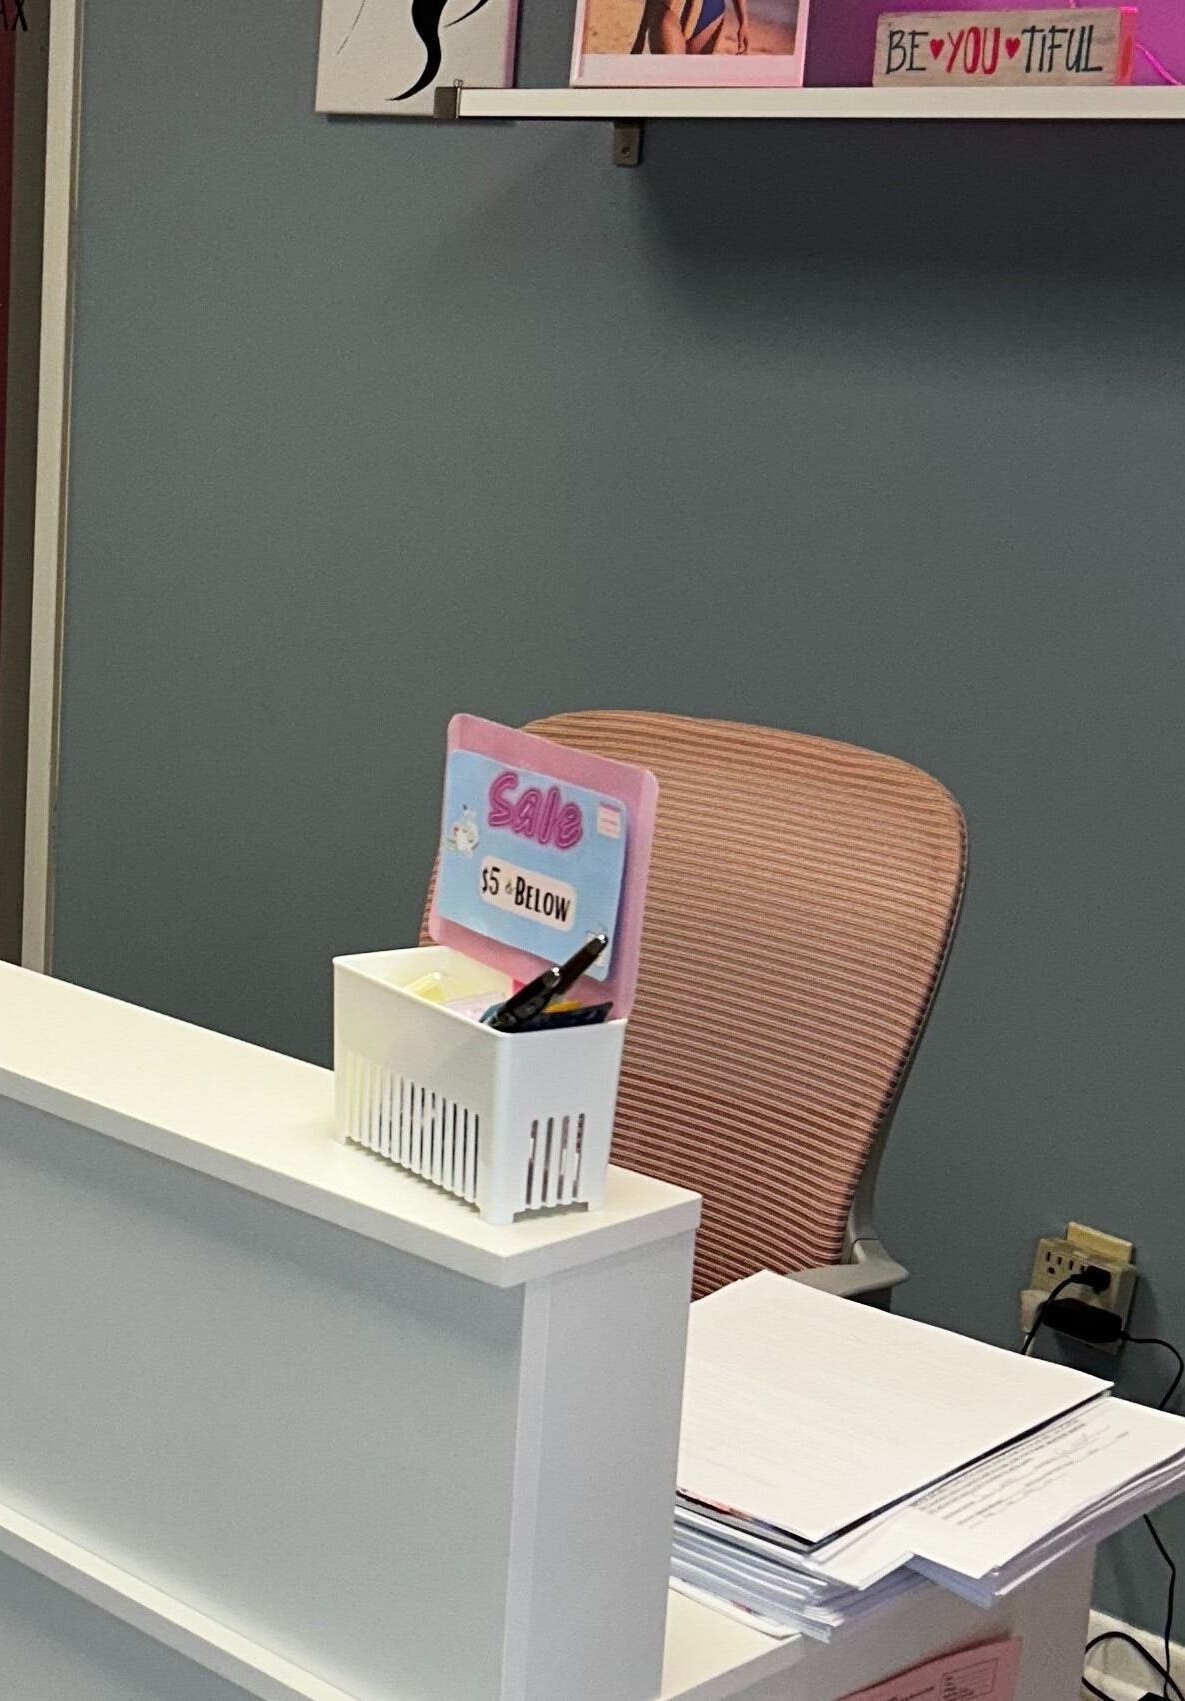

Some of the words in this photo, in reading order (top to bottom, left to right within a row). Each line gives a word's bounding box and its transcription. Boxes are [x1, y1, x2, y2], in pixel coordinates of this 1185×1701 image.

[885, 29, 930, 75] BE
[943, 26, 1001, 75] YOU
[1022, 25, 1103, 74] TIFUL
[488, 772, 583, 849] Sale
[481, 864, 501, 895] $5
[514, 876, 572, 922] BELOW
